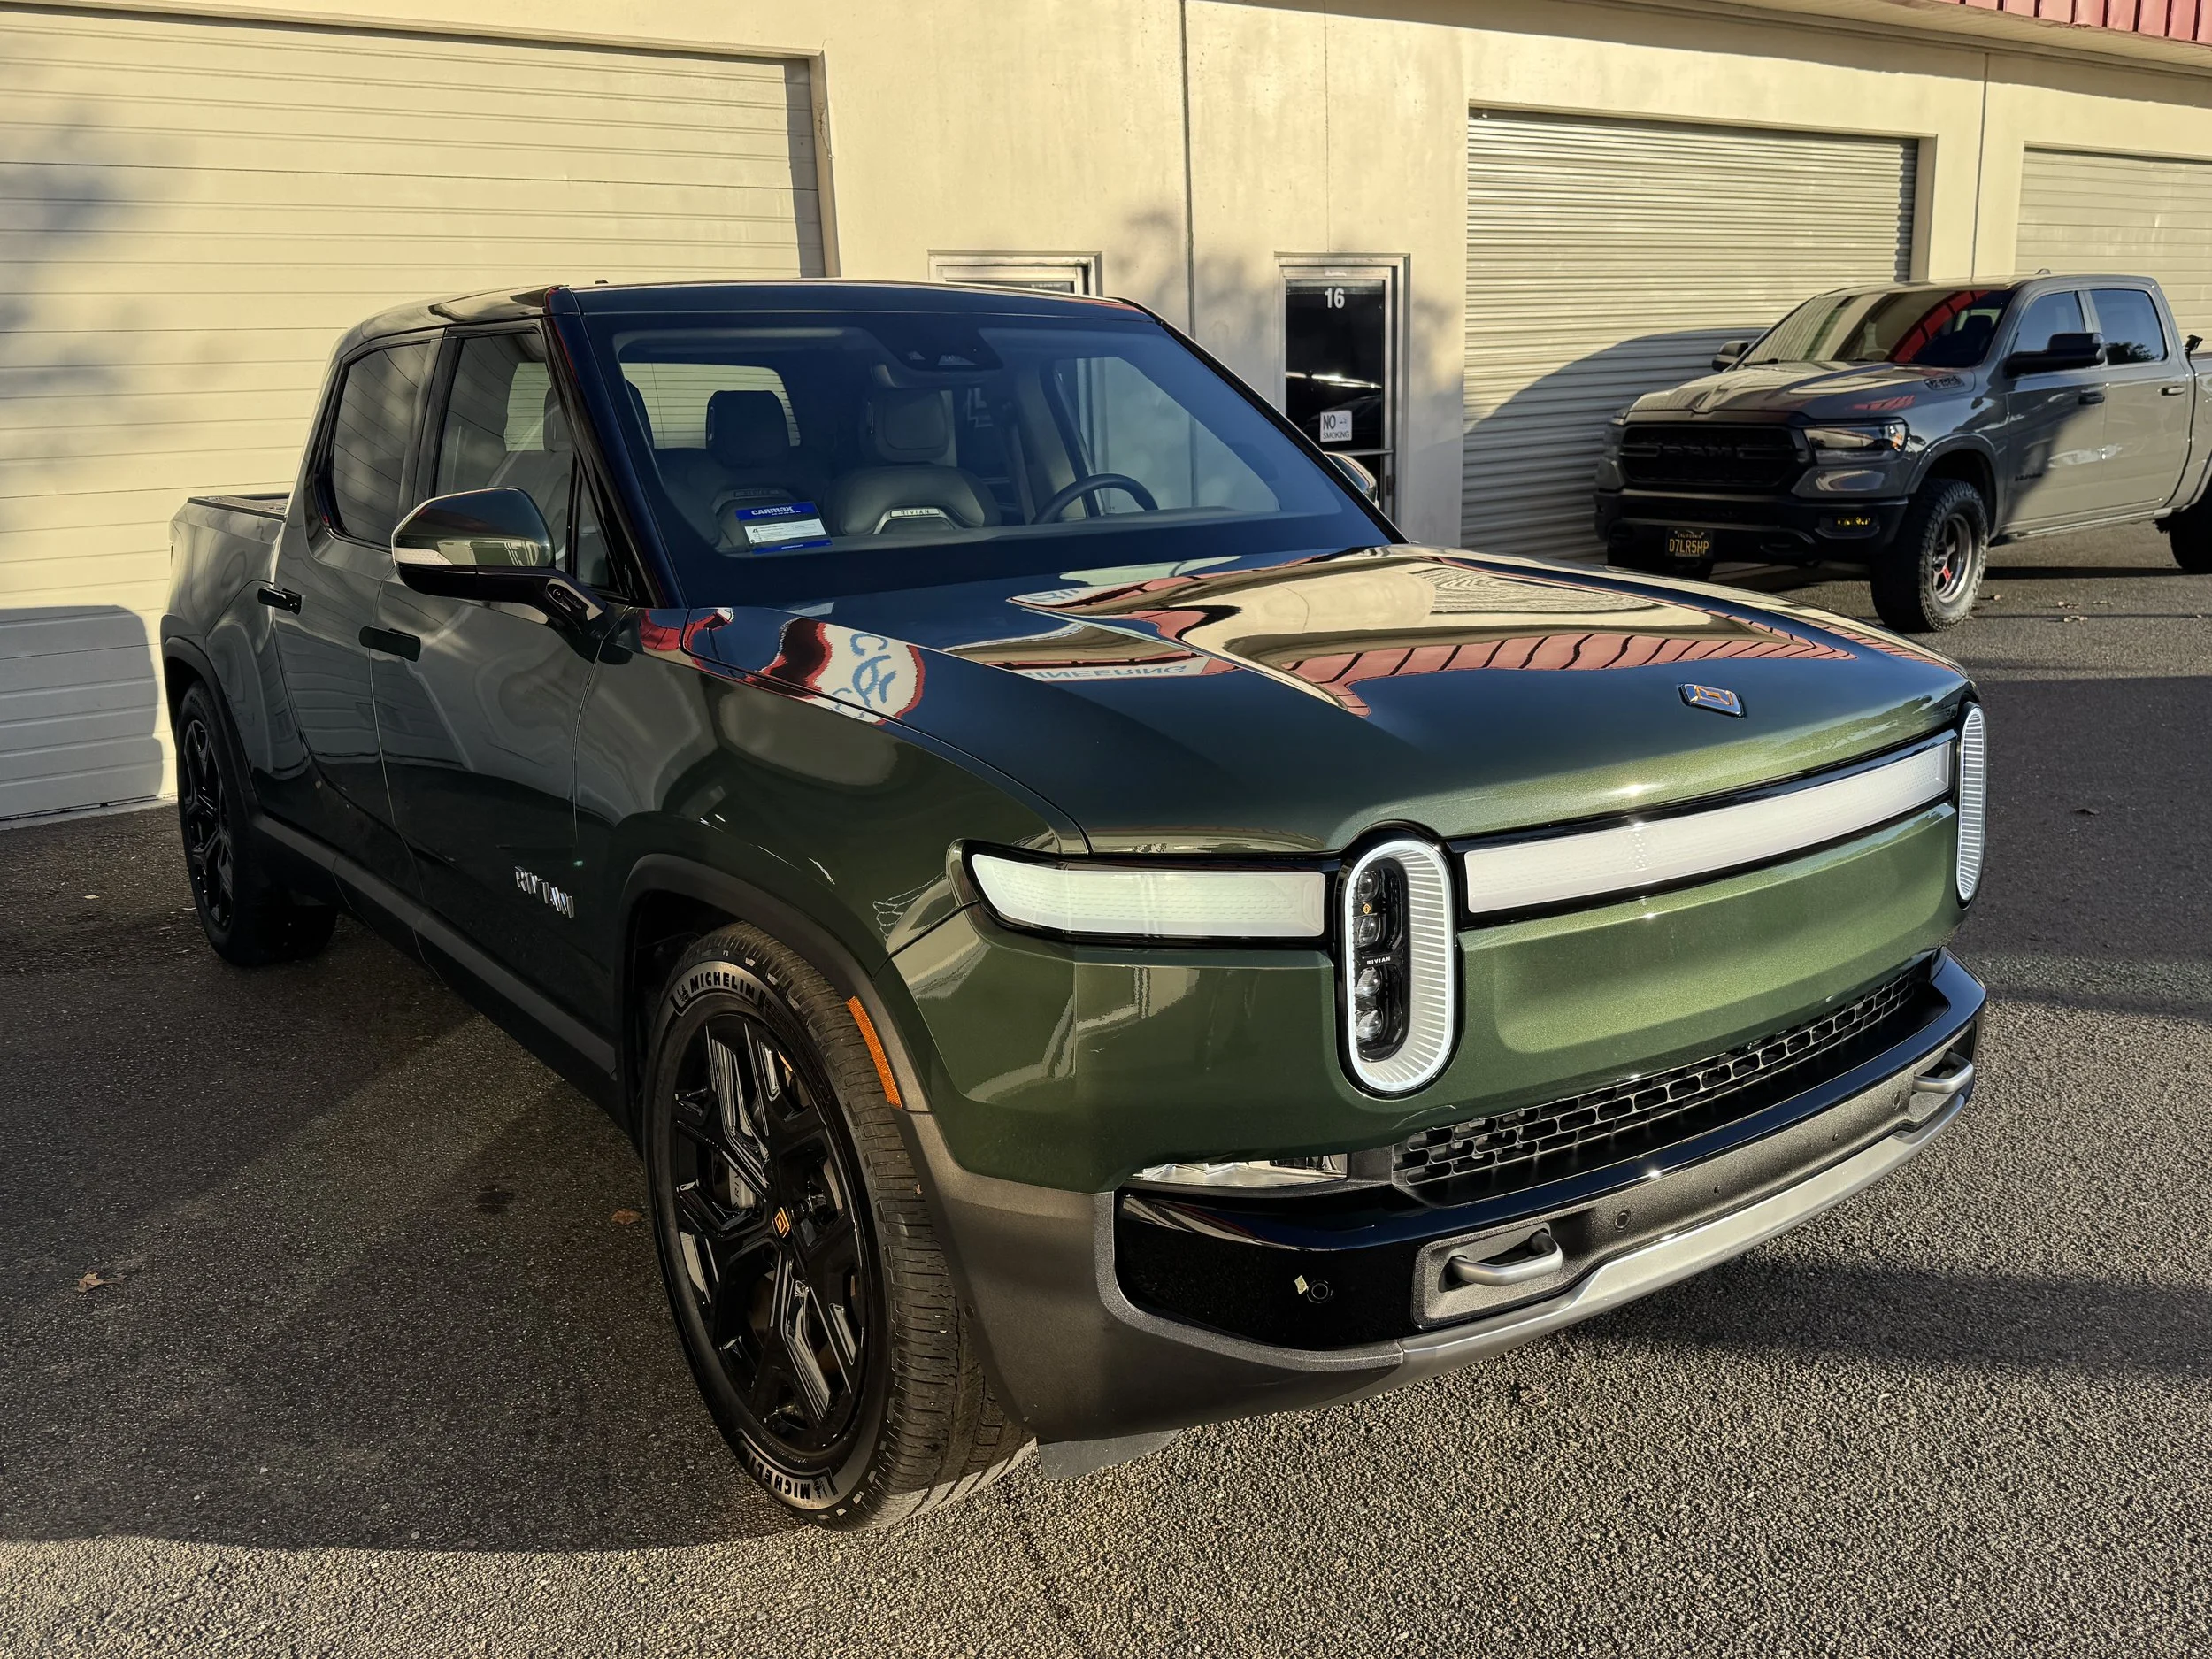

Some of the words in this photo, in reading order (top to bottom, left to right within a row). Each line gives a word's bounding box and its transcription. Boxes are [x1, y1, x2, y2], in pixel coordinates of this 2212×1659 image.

[1324, 288, 1345, 309] 16
[1323, 414, 1336, 430] NO
[1323, 431, 1350, 440] SMOKING
[1366, 956, 1391, 965] RIVIAN
[690, 971, 756, 1000] MICHELIN
